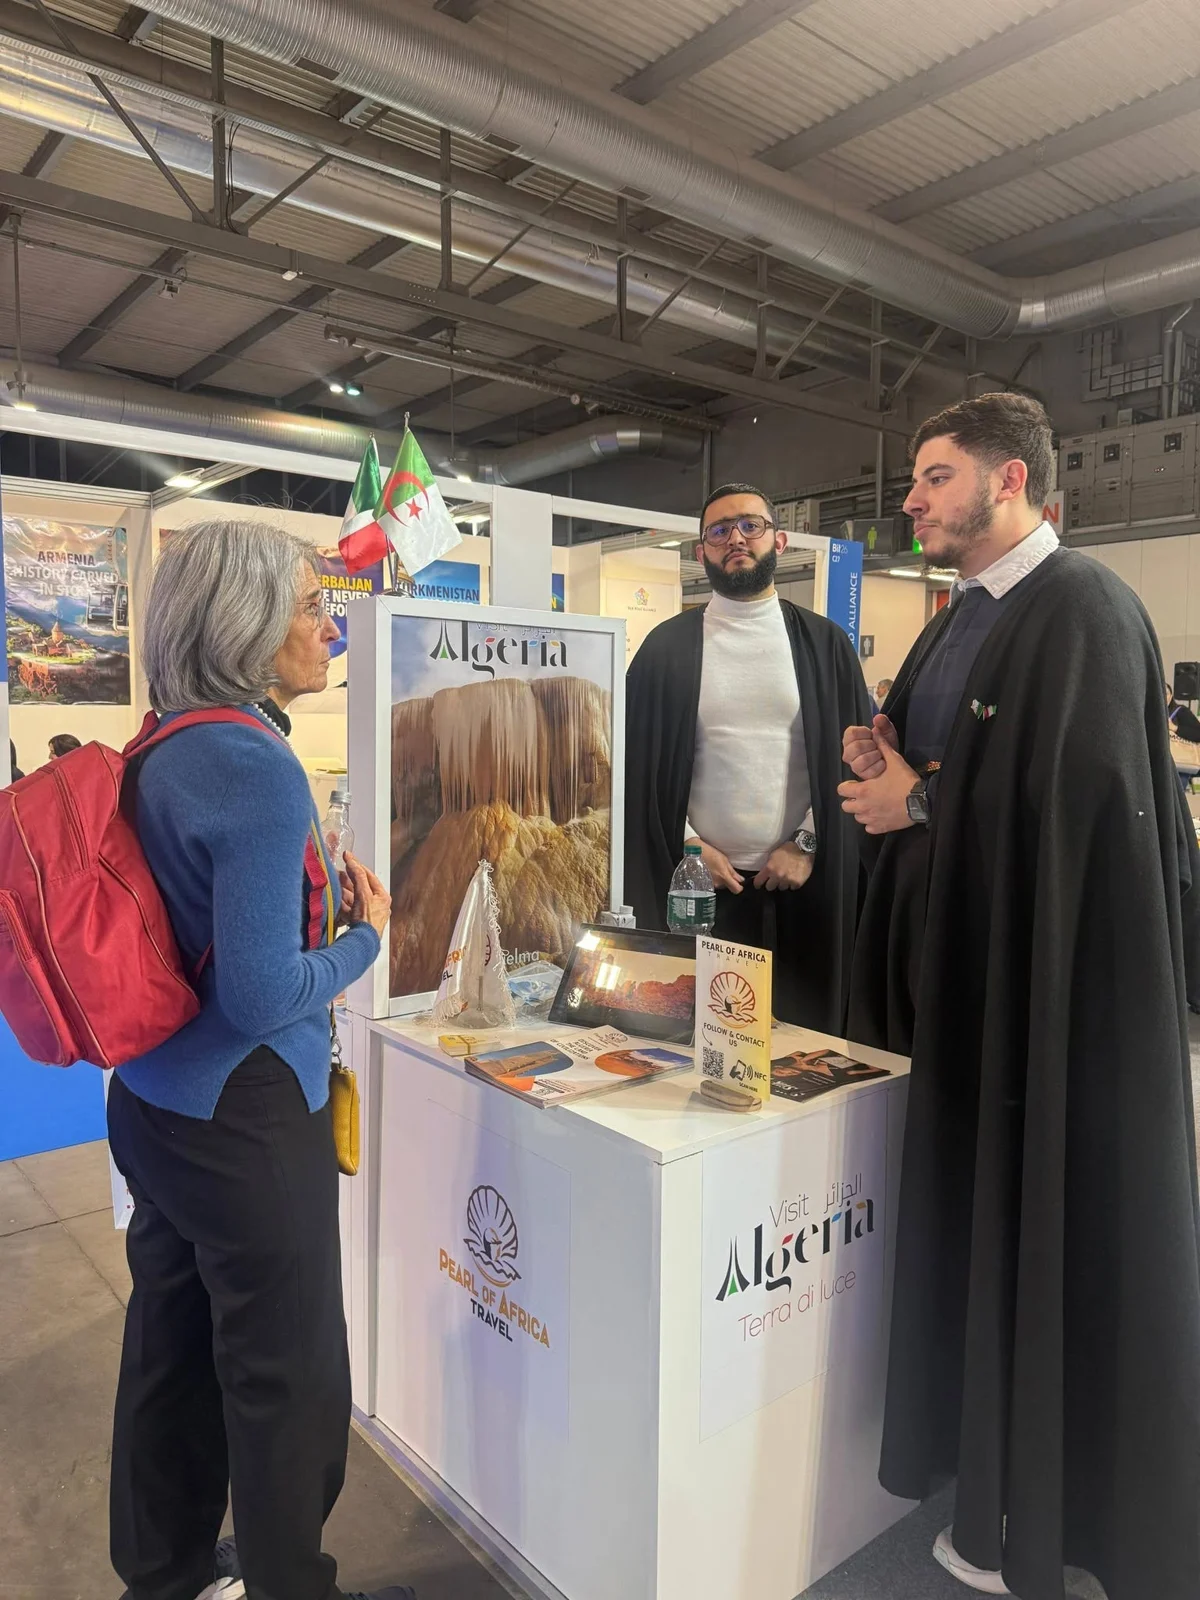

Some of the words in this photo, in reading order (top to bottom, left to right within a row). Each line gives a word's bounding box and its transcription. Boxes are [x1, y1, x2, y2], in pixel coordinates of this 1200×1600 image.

[37, 550, 96, 566] ARMENIA
[40, 582, 54, 596] IN
[848, 572, 858, 630] ALLIANCE
[429, 619, 568, 680] Algeria
[505, 947, 540, 966] elma
[701, 940, 724, 953] PEARL
[725, 946, 736, 956] OF
[737, 949, 767, 964] AFRICA
[703, 1022, 728, 1036] FOLLOW
[735, 1033, 765, 1048] CONTACT
[728, 1039, 738, 1047] US
[754, 1071, 767, 1082] NFC
[769, 1193, 809, 1228] Visit
[824, 1172, 862, 1214] الجزائر
[715, 1198, 875, 1302] Algeria
[439, 1247, 479, 1298] PEARL
[482, 1285, 496, 1307] OF
[498, 1289, 550, 1349] AFRICA
[738, 1301, 791, 1342] Terra
[797, 1284, 814, 1313] di
[820, 1270, 856, 1303] luce
[470, 1298, 513, 1343] TRAVEL
